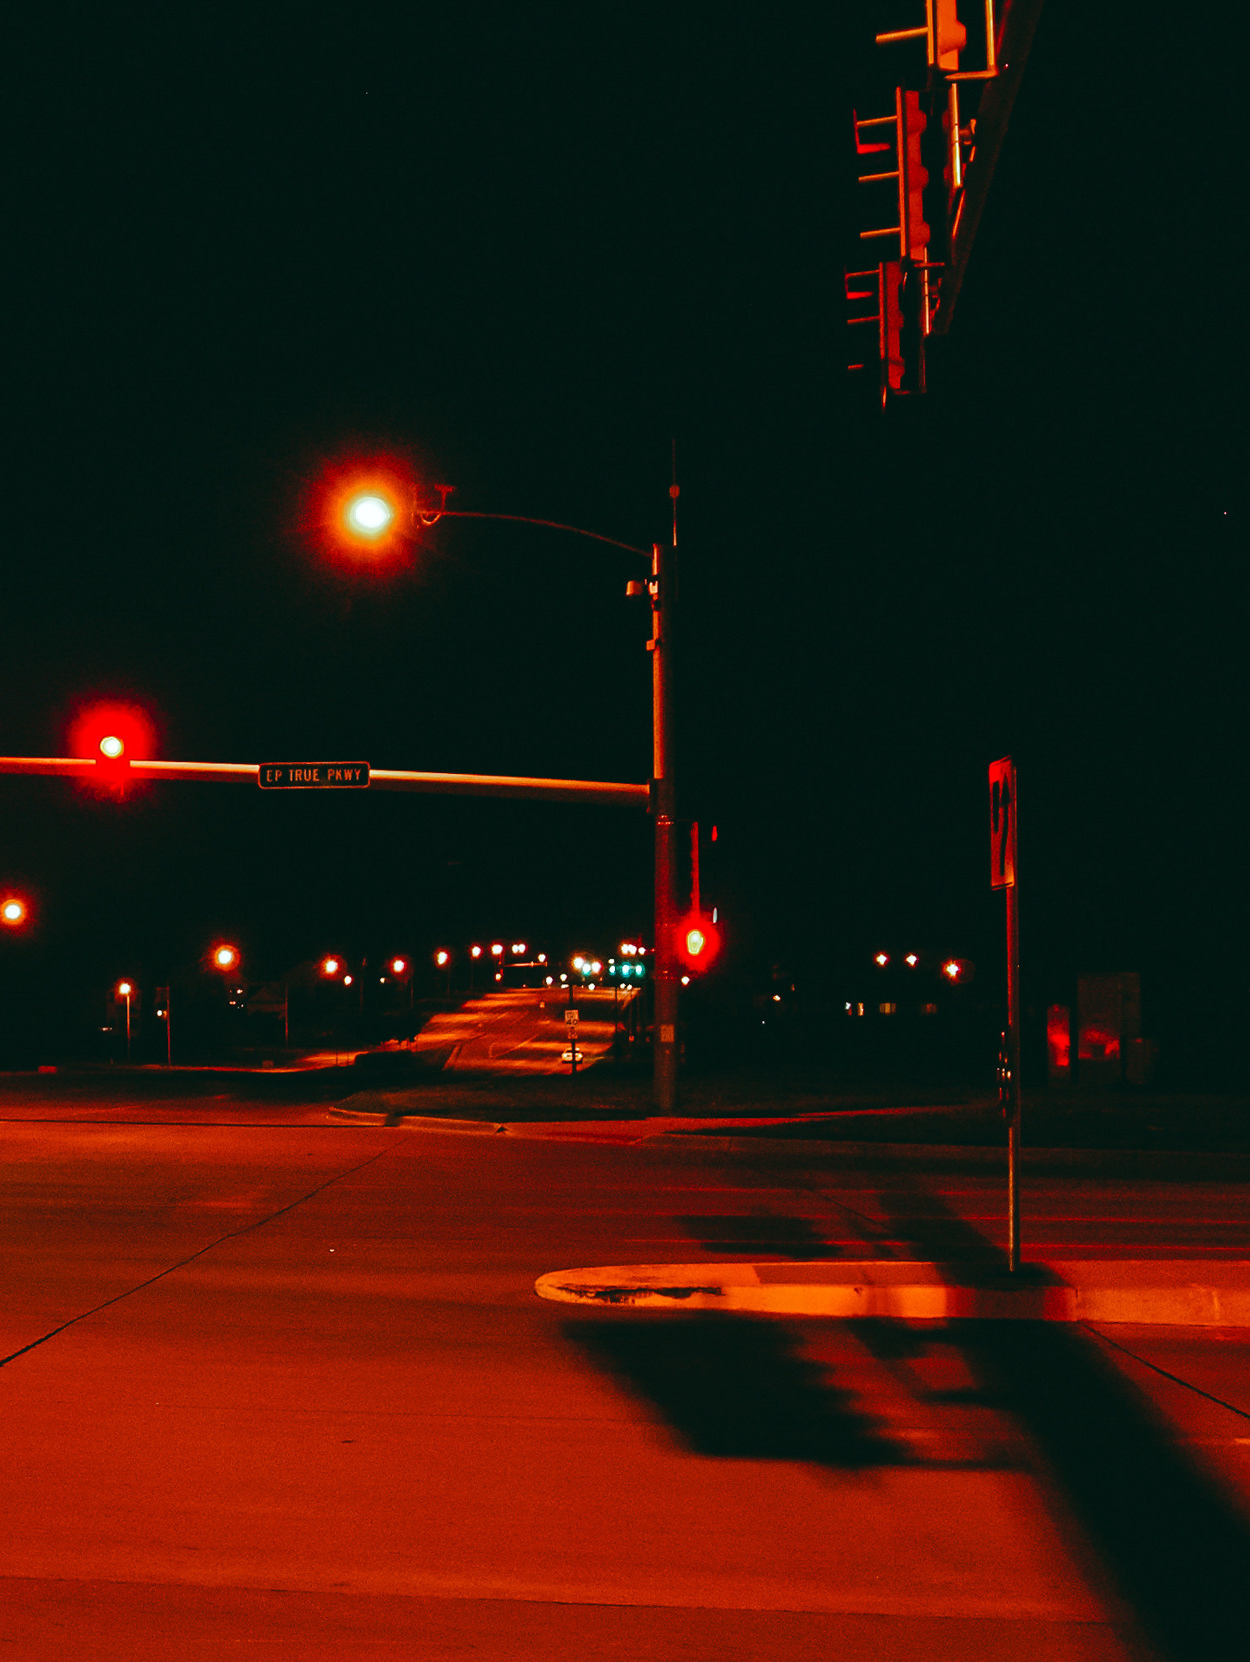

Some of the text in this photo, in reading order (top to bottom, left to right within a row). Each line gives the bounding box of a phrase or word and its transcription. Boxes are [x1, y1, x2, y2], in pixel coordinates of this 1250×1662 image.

[266, 768, 361, 782] EP TRUE PKWY
